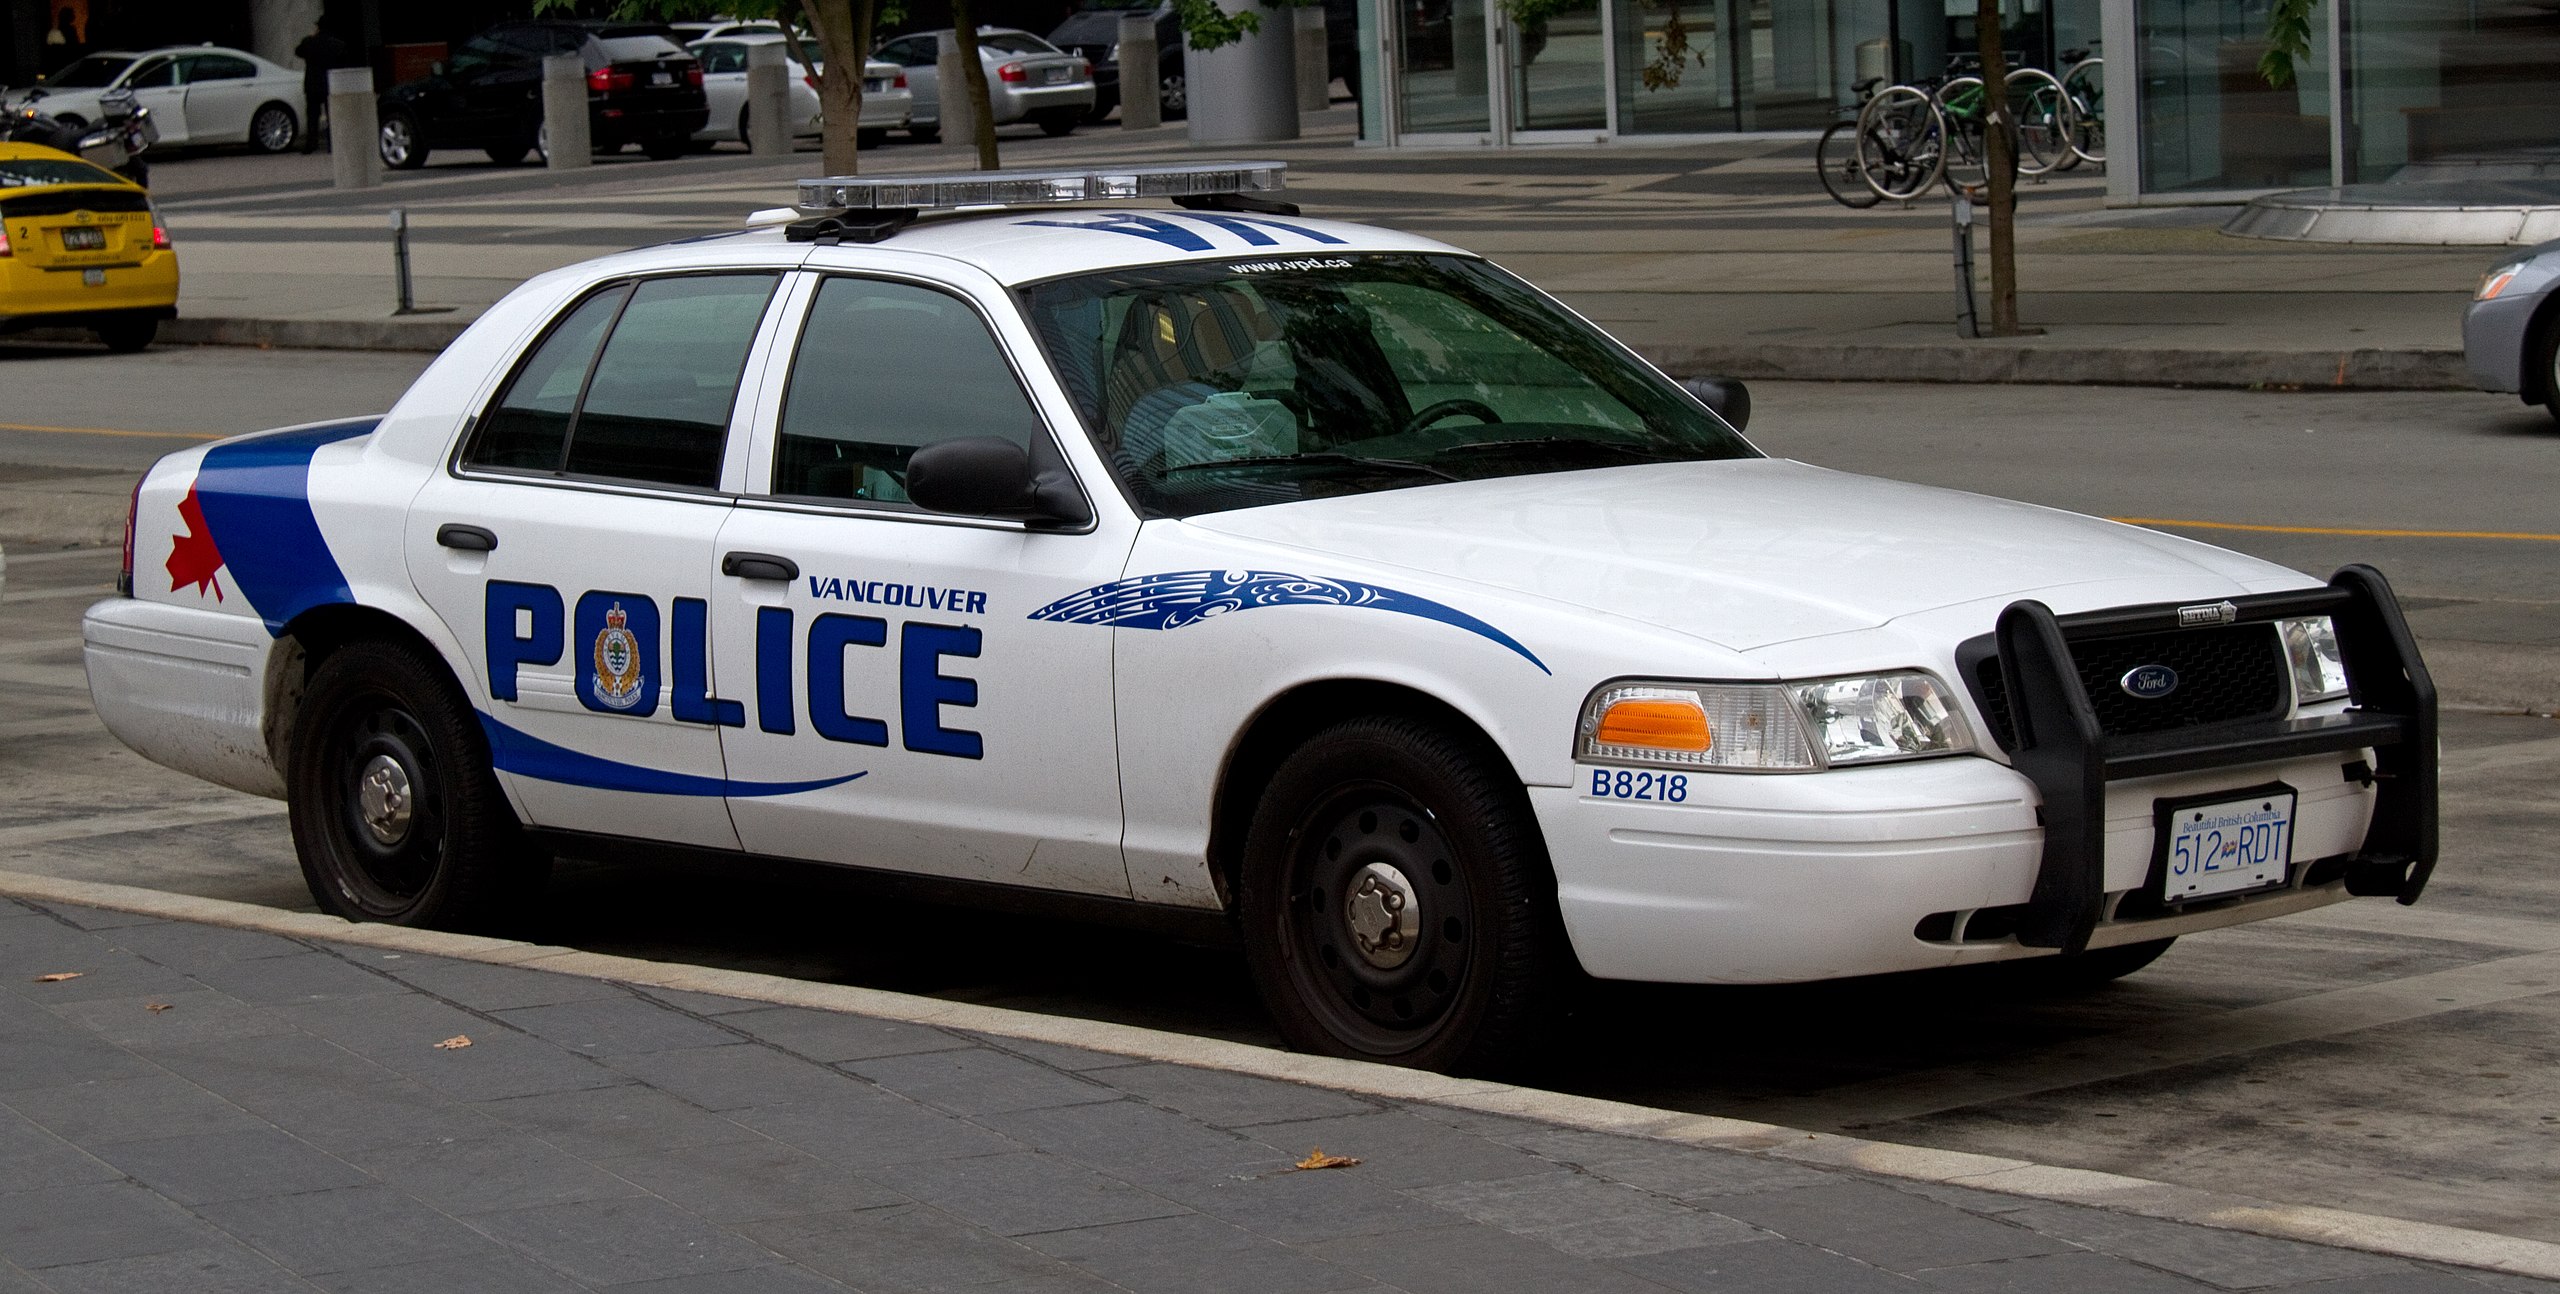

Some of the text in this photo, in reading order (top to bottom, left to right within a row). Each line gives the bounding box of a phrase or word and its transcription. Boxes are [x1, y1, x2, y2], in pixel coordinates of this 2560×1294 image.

[20, 226, 29, 239] 2
[1229, 257, 1353, 274] www.vpd.ca
[809, 575, 987, 614] VANCOUVER
[485, 578, 984, 760] POLICE
[2137, 671, 2167, 690] Ford
[1592, 769, 1688, 803] B8218
[2183, 809, 2281, 834] Beautiful British Columbia
[2174, 820, 2287, 875] 512 RDT
